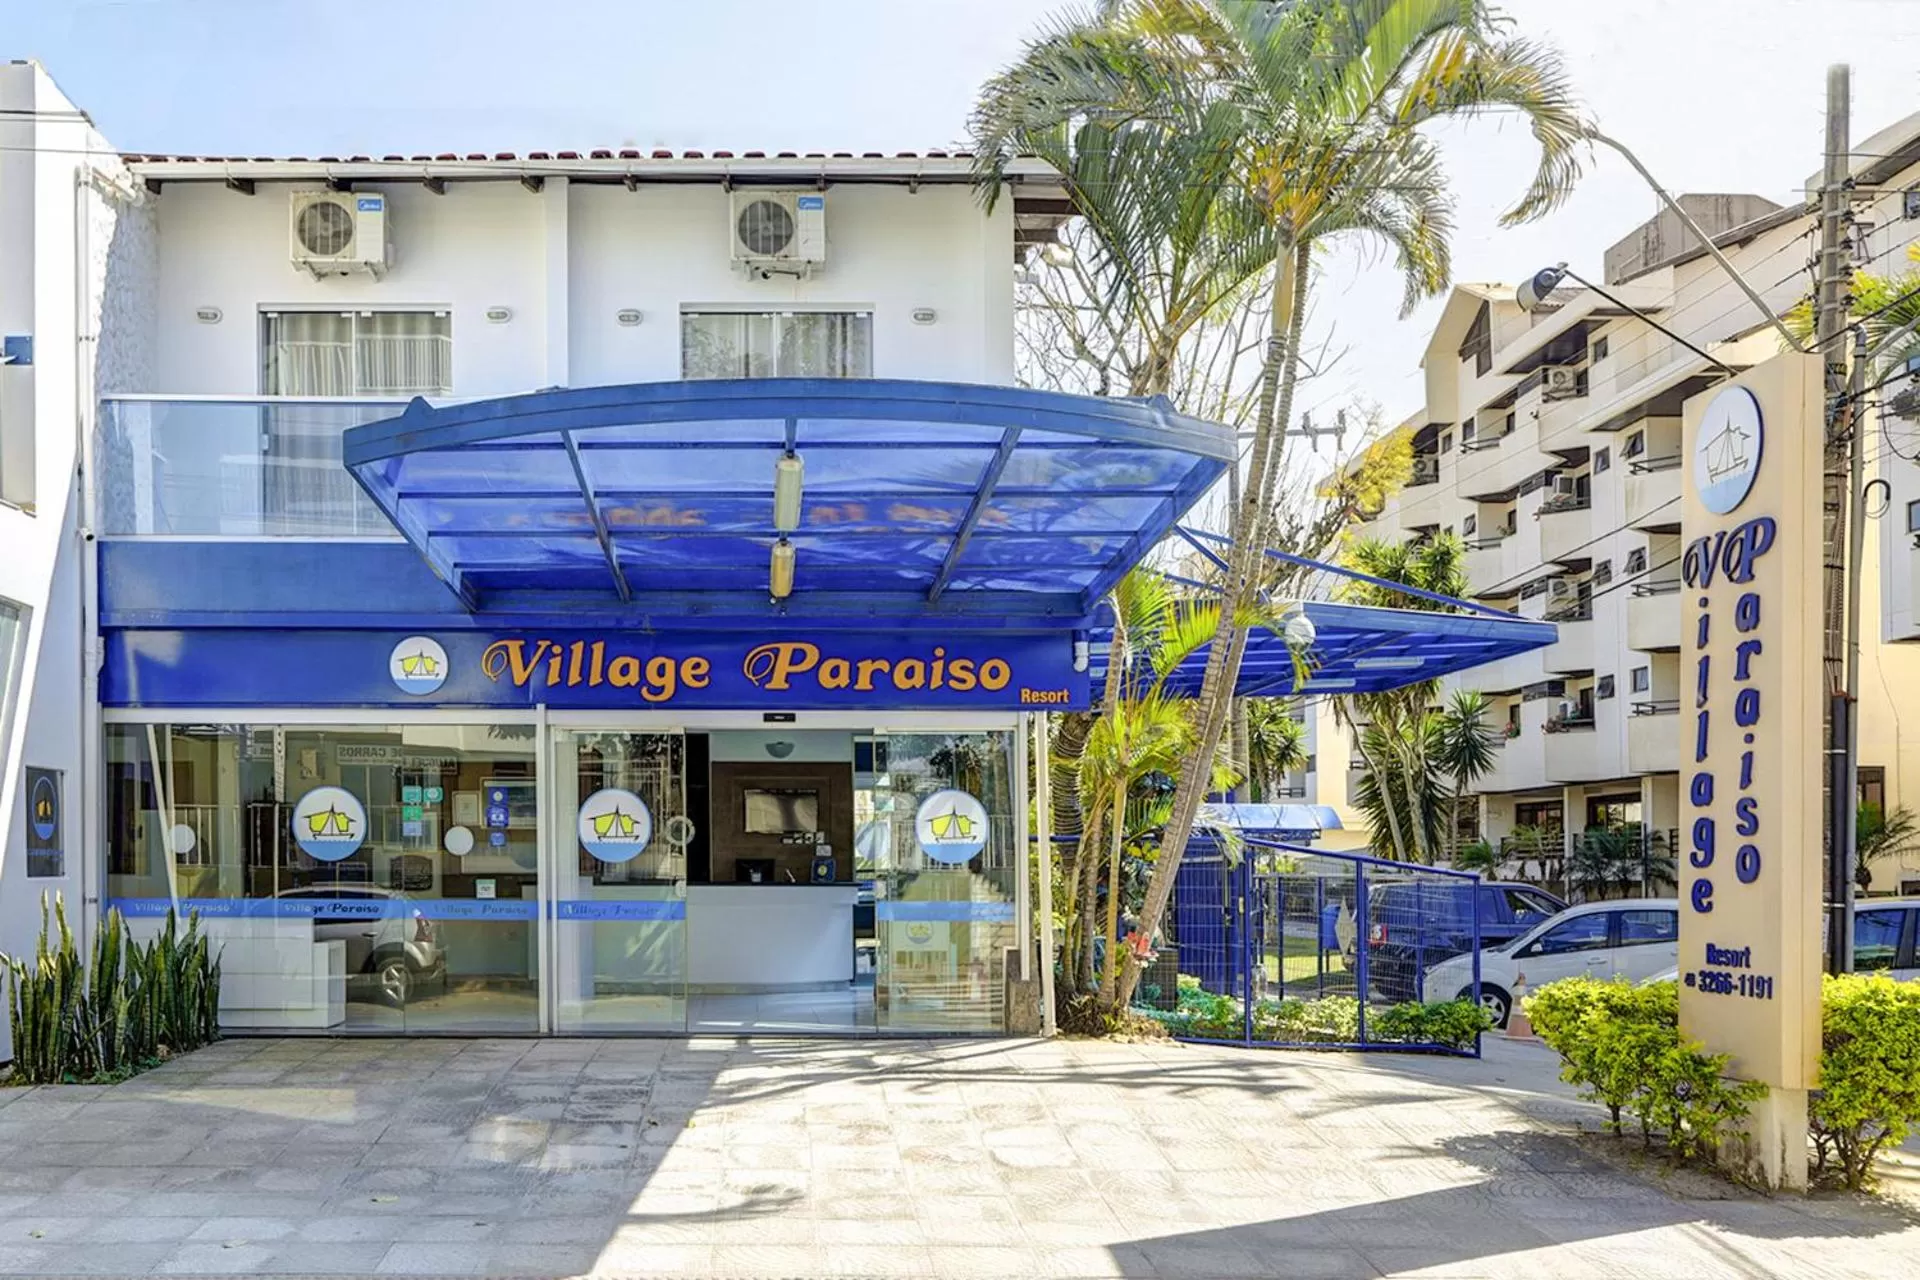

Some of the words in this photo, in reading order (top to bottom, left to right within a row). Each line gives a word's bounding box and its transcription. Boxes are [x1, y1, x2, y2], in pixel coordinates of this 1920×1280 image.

[481, 640, 710, 702] Village
[743, 641, 1011, 691] Paraiso
[1020, 688, 1070, 704] Resort
[1722, 516, 1777, 884] Paraiso
[1682, 531, 1727, 914] Village
[1706, 943, 1751, 968] Resort
[1698, 970, 1773, 1000] 3266-1191
